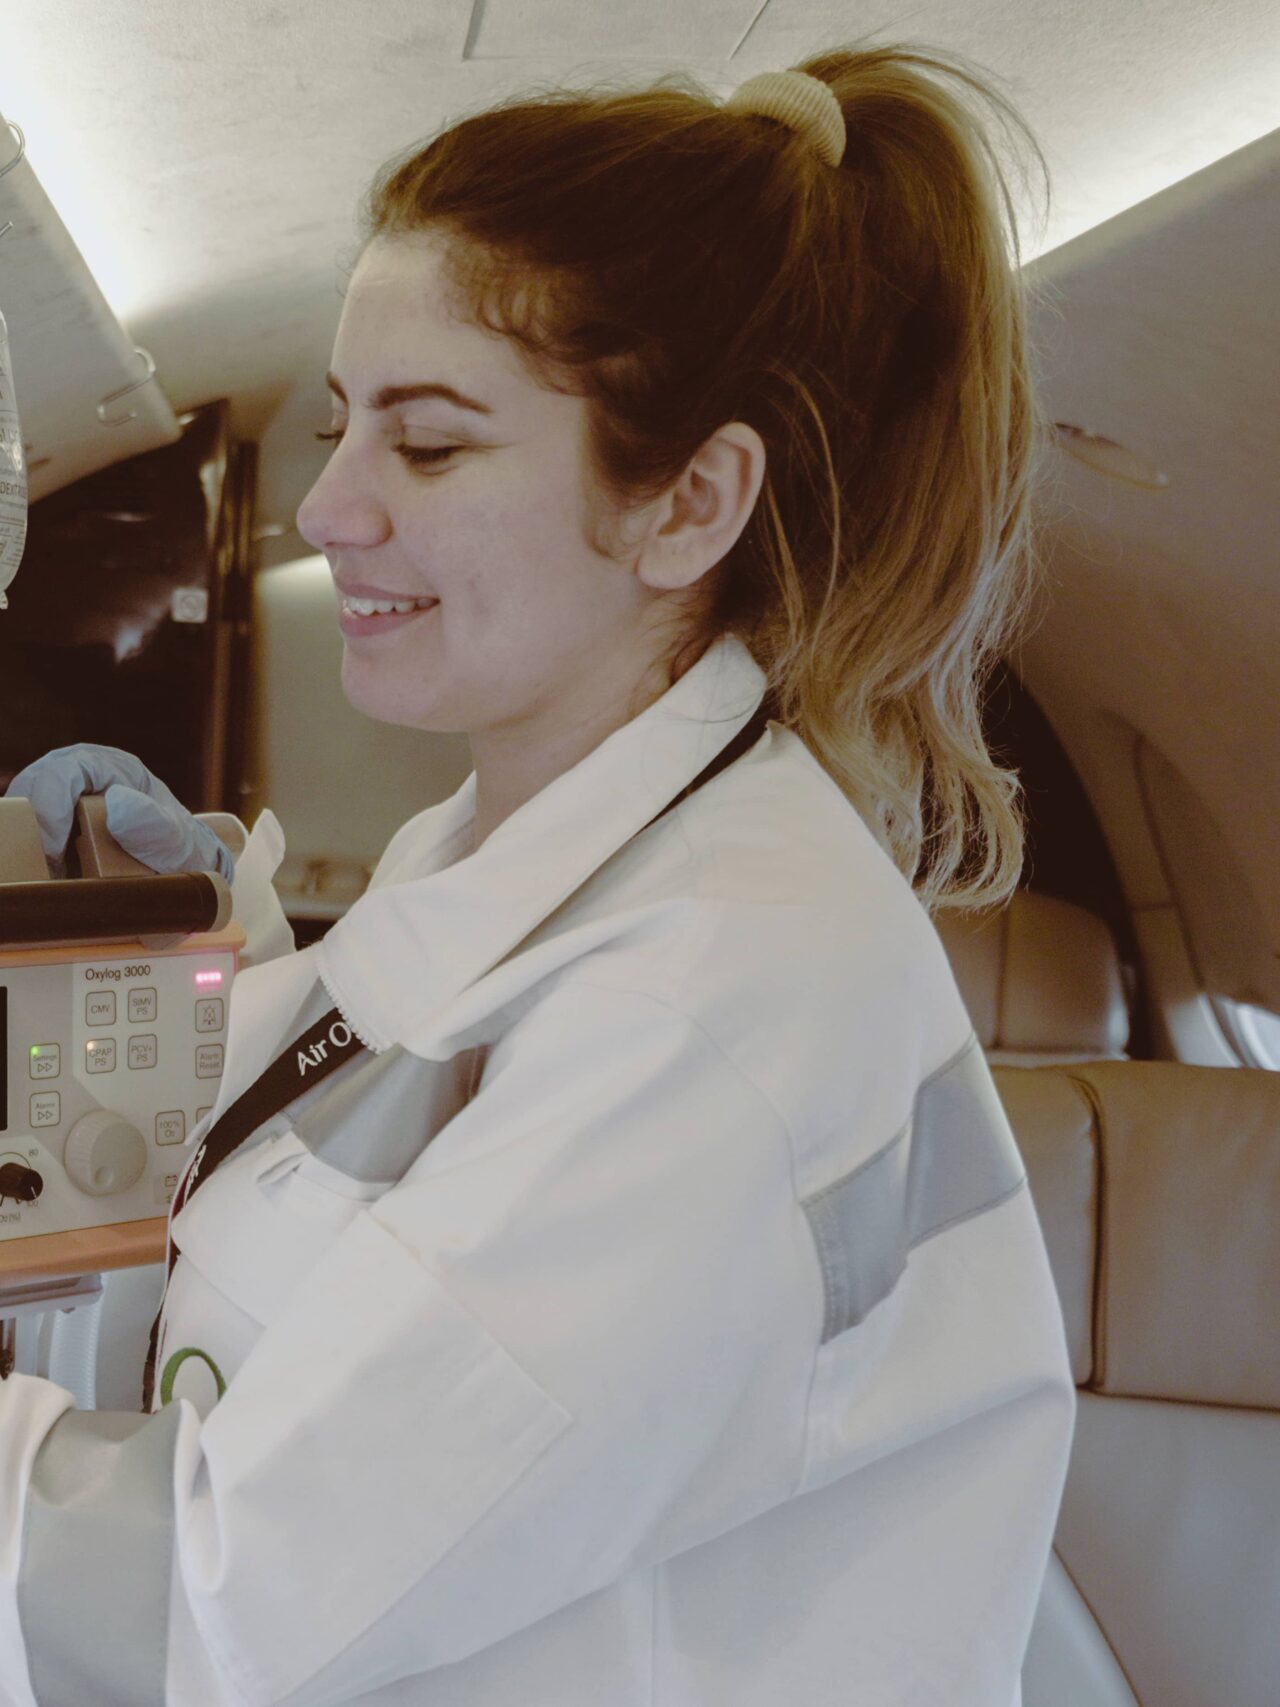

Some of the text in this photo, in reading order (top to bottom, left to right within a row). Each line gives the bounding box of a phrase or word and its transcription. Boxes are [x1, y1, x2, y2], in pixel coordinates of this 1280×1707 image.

[85, 964, 152, 983] Oxylog 3000
[131, 997, 153, 1008] SIMV
[90, 1004, 111, 1015] CMV
[136, 1006, 149, 1016] PS
[88, 1047, 113, 1059] CPAP
[199, 1053, 220, 1062] Alarm
[297, 1039, 329, 1077] Air
[94, 1057, 107, 1067] PS
[136, 1054, 149, 1064] PS
[199, 1061, 220, 1071] Reset
[159, 1120, 180, 1131] 100%
[28, 1148, 39, 1157] 80
